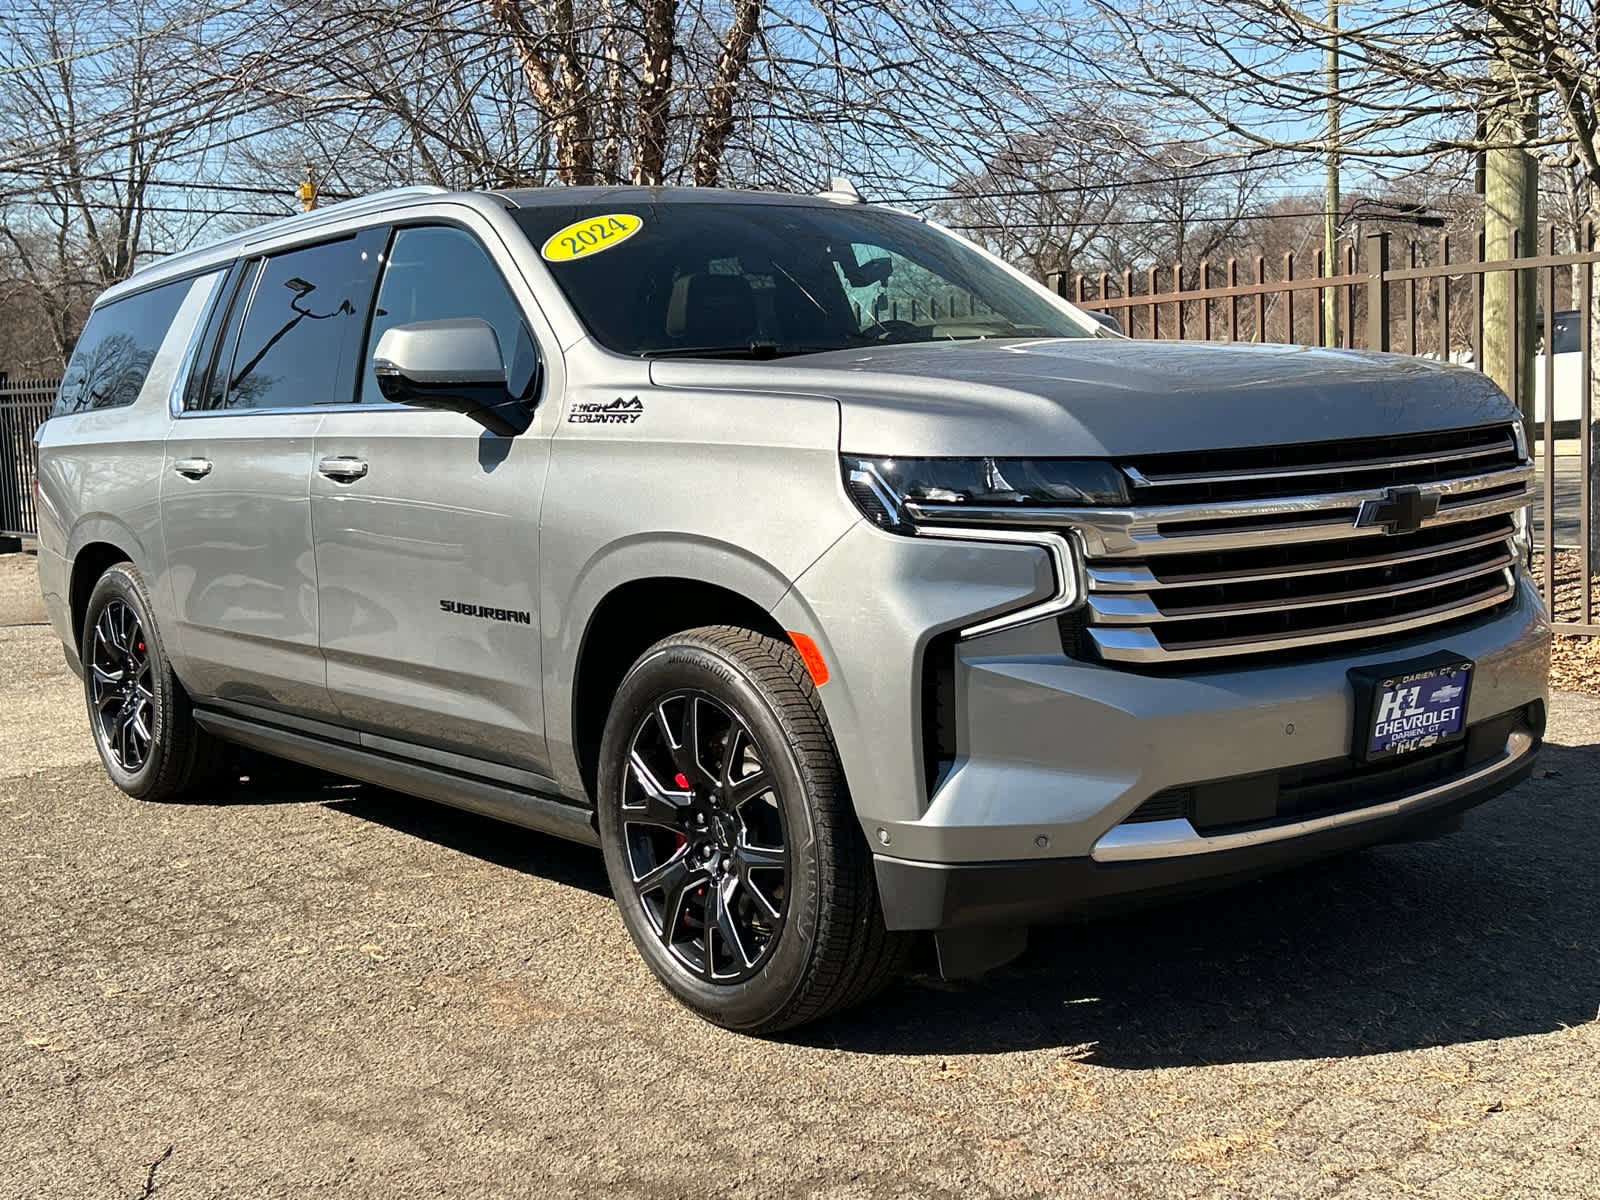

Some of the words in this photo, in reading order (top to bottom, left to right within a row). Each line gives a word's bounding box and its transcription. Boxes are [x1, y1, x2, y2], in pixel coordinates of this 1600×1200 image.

[561, 218, 629, 255] 2024
[568, 414, 641, 424] COUNTRY
[571, 403, 609, 413] HIGH
[440, 600, 531, 625] SUBURBAN
[1376, 686, 1425, 724] H&L
[1375, 706, 1460, 737] CHEVROLET
[1429, 724, 1440, 732] CT
